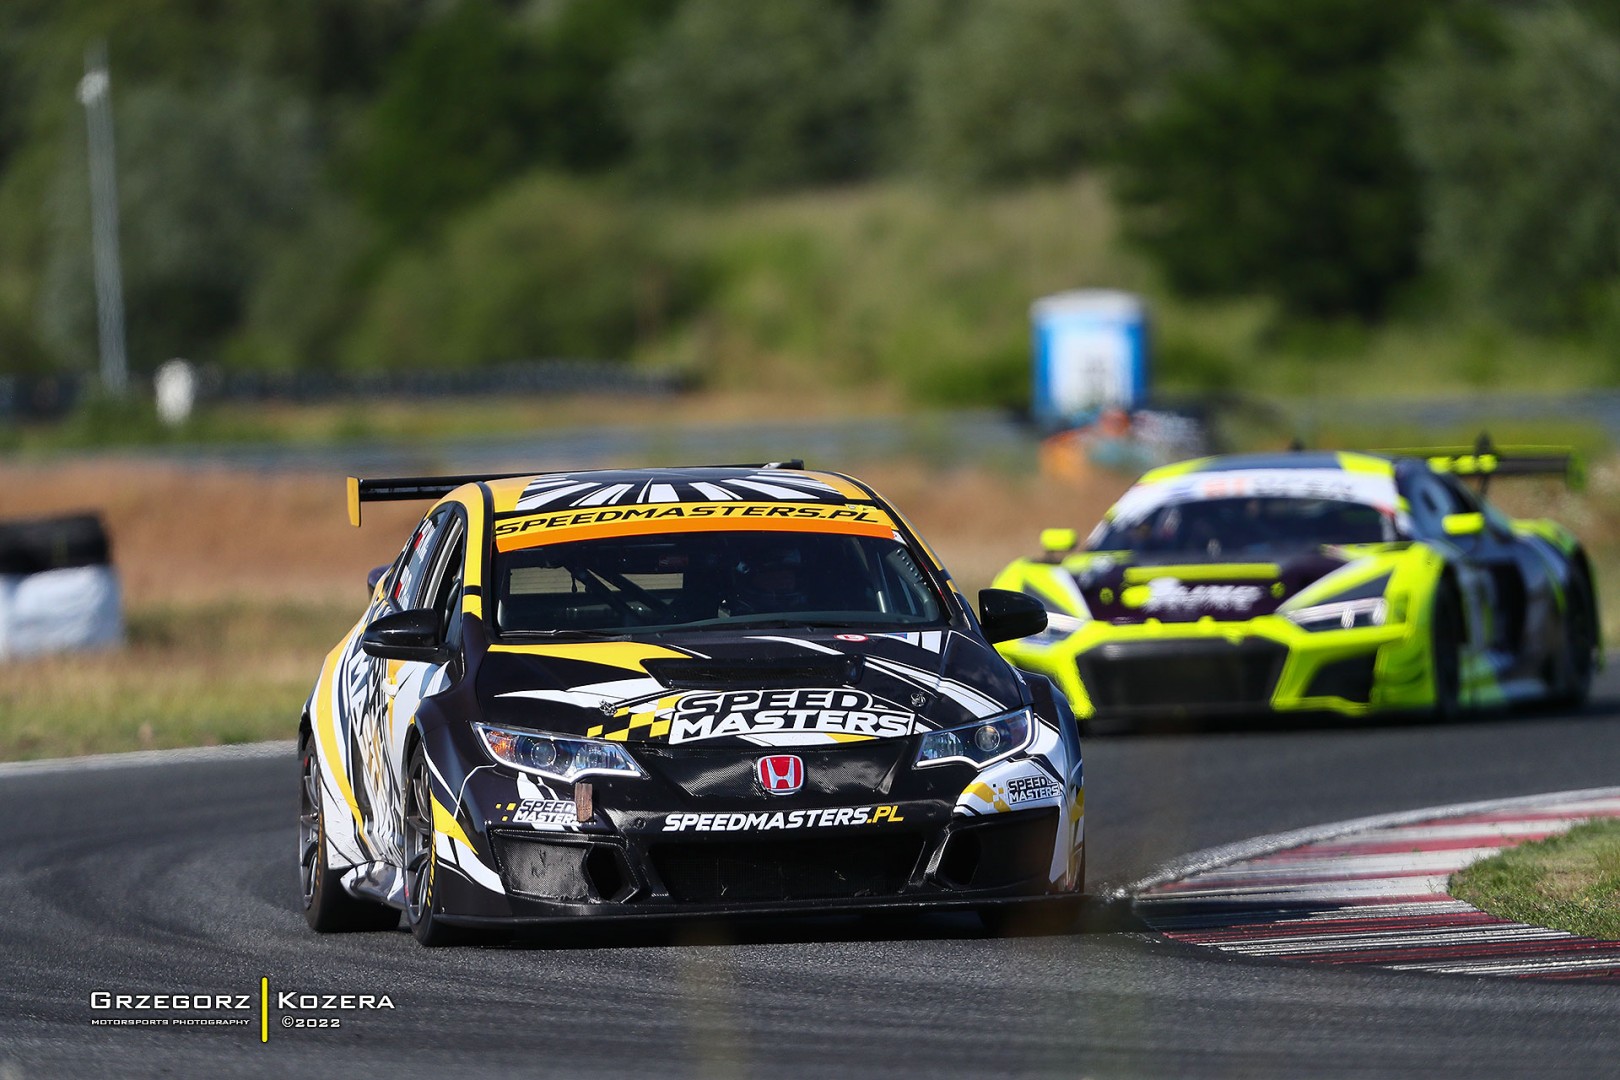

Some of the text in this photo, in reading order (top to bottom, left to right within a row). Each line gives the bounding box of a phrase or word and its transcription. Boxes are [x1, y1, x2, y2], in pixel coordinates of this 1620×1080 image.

[495, 505, 878, 537] SPEEDMASTERS.PL
[677, 690, 870, 714] SPEED
[669, 709, 912, 744] MASTERS
[1008, 776, 1047, 792] SPEED
[1009, 784, 1059, 803] MASTERS
[662, 806, 904, 832] SPEEDMASTERS.PL
